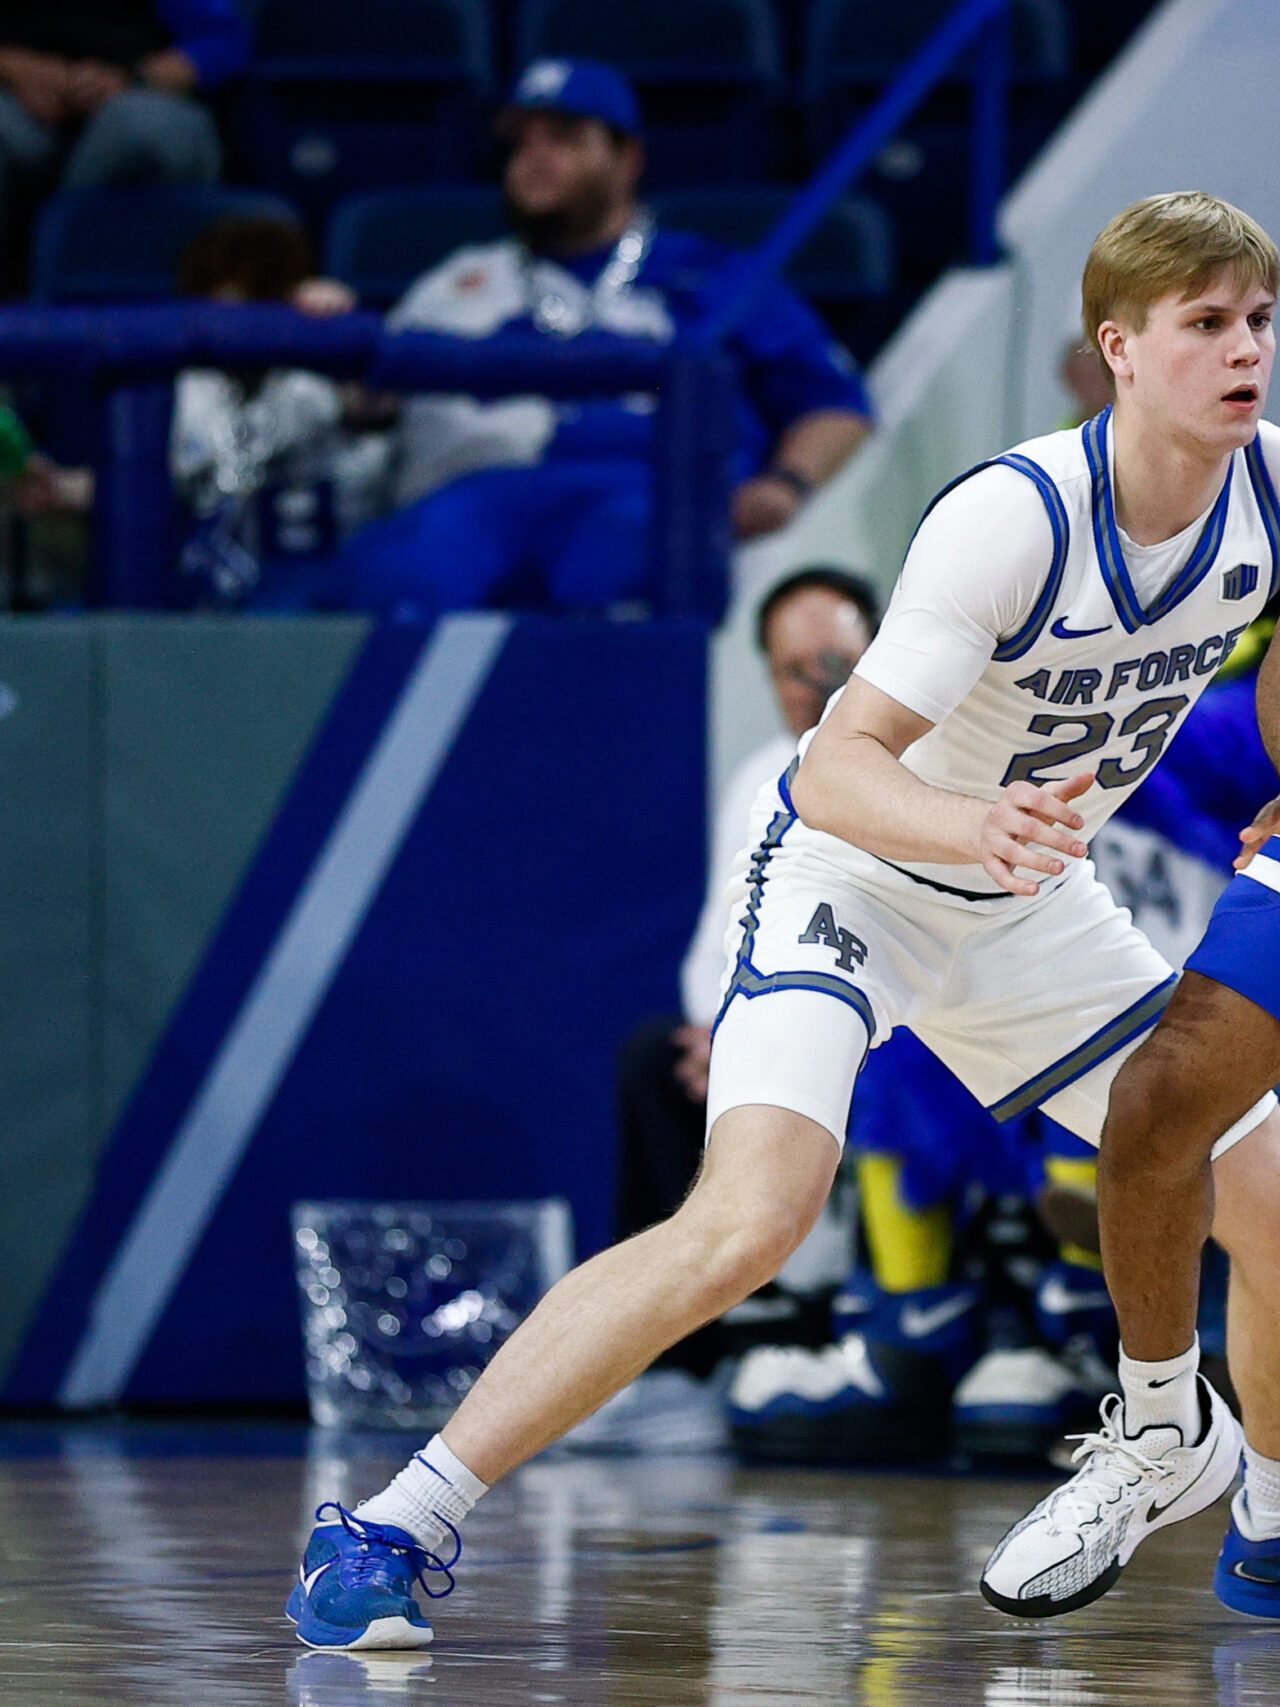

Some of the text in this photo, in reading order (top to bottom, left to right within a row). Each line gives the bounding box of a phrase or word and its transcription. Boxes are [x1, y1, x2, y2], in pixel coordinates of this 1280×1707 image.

[1013, 622, 1249, 706] AIR FORCE
[999, 695, 1190, 789] 23
[798, 902, 868, 974] AF
